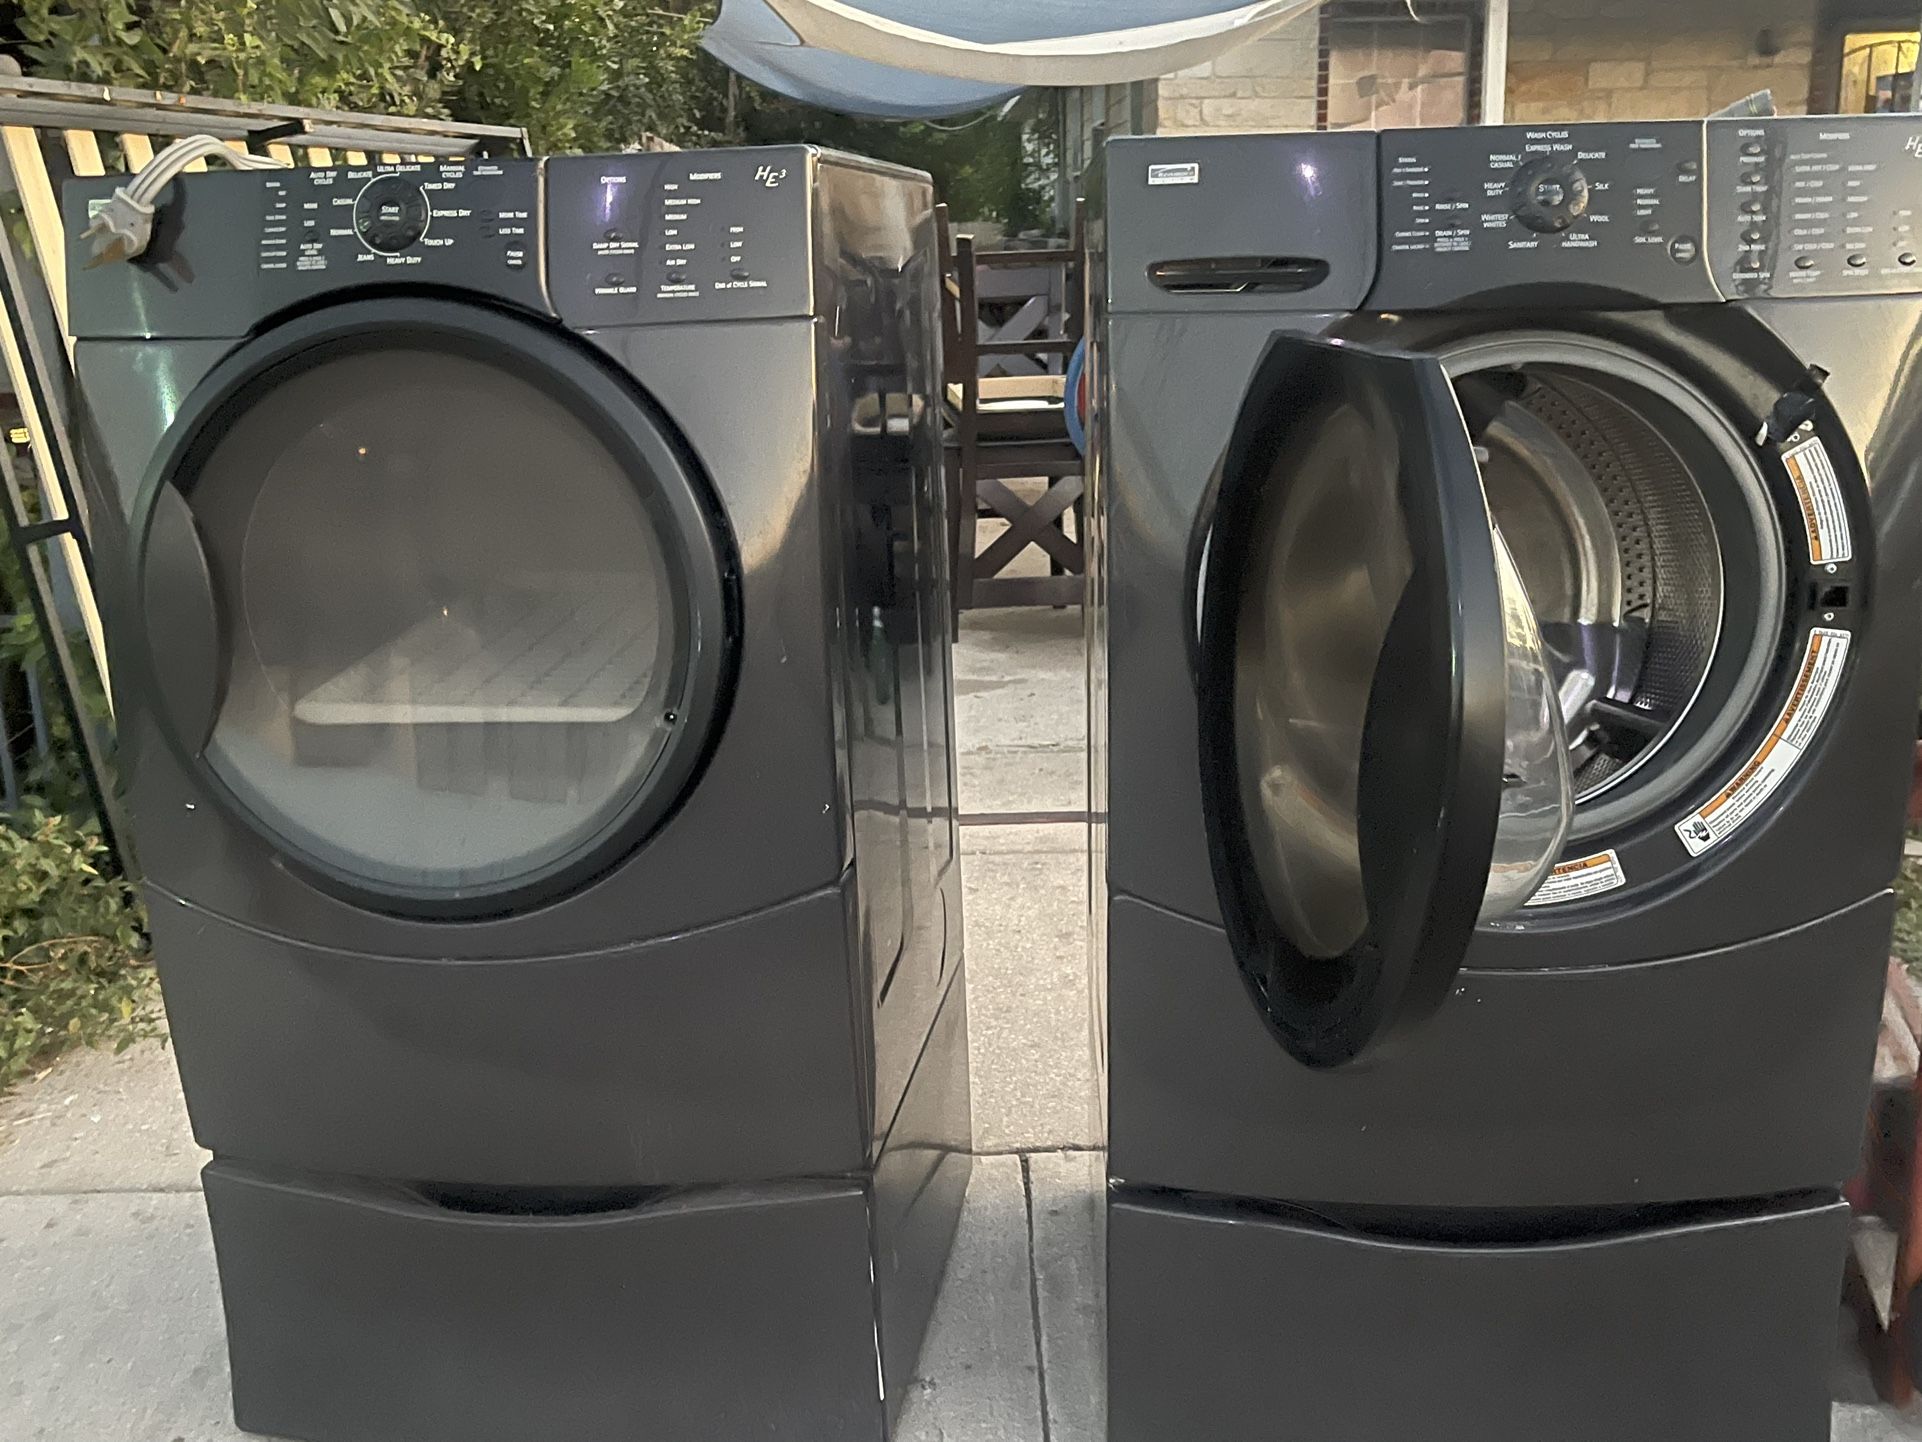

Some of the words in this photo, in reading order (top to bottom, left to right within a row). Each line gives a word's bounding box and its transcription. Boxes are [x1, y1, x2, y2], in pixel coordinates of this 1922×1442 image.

[1547, 131, 1569, 139] CYCLES
[1738, 129, 1765, 137] OPTIONS
[1526, 144, 1551, 152] EXPRESS
[348, 171, 372, 179] DELICATE
[690, 172, 721, 180] MODIFIERS
[601, 176, 626, 184] OPTIONS
[1539, 184, 1560, 192] START
[1595, 182, 1609, 190] SILK
[424, 238, 443, 246] TOUCH
[1508, 241, 1539, 249] SANITARY
[1786, 650, 1818, 719] AVERTISSEMENT
[1729, 760, 1760, 795] WARNING
[1554, 862, 1588, 875] TENCIA
